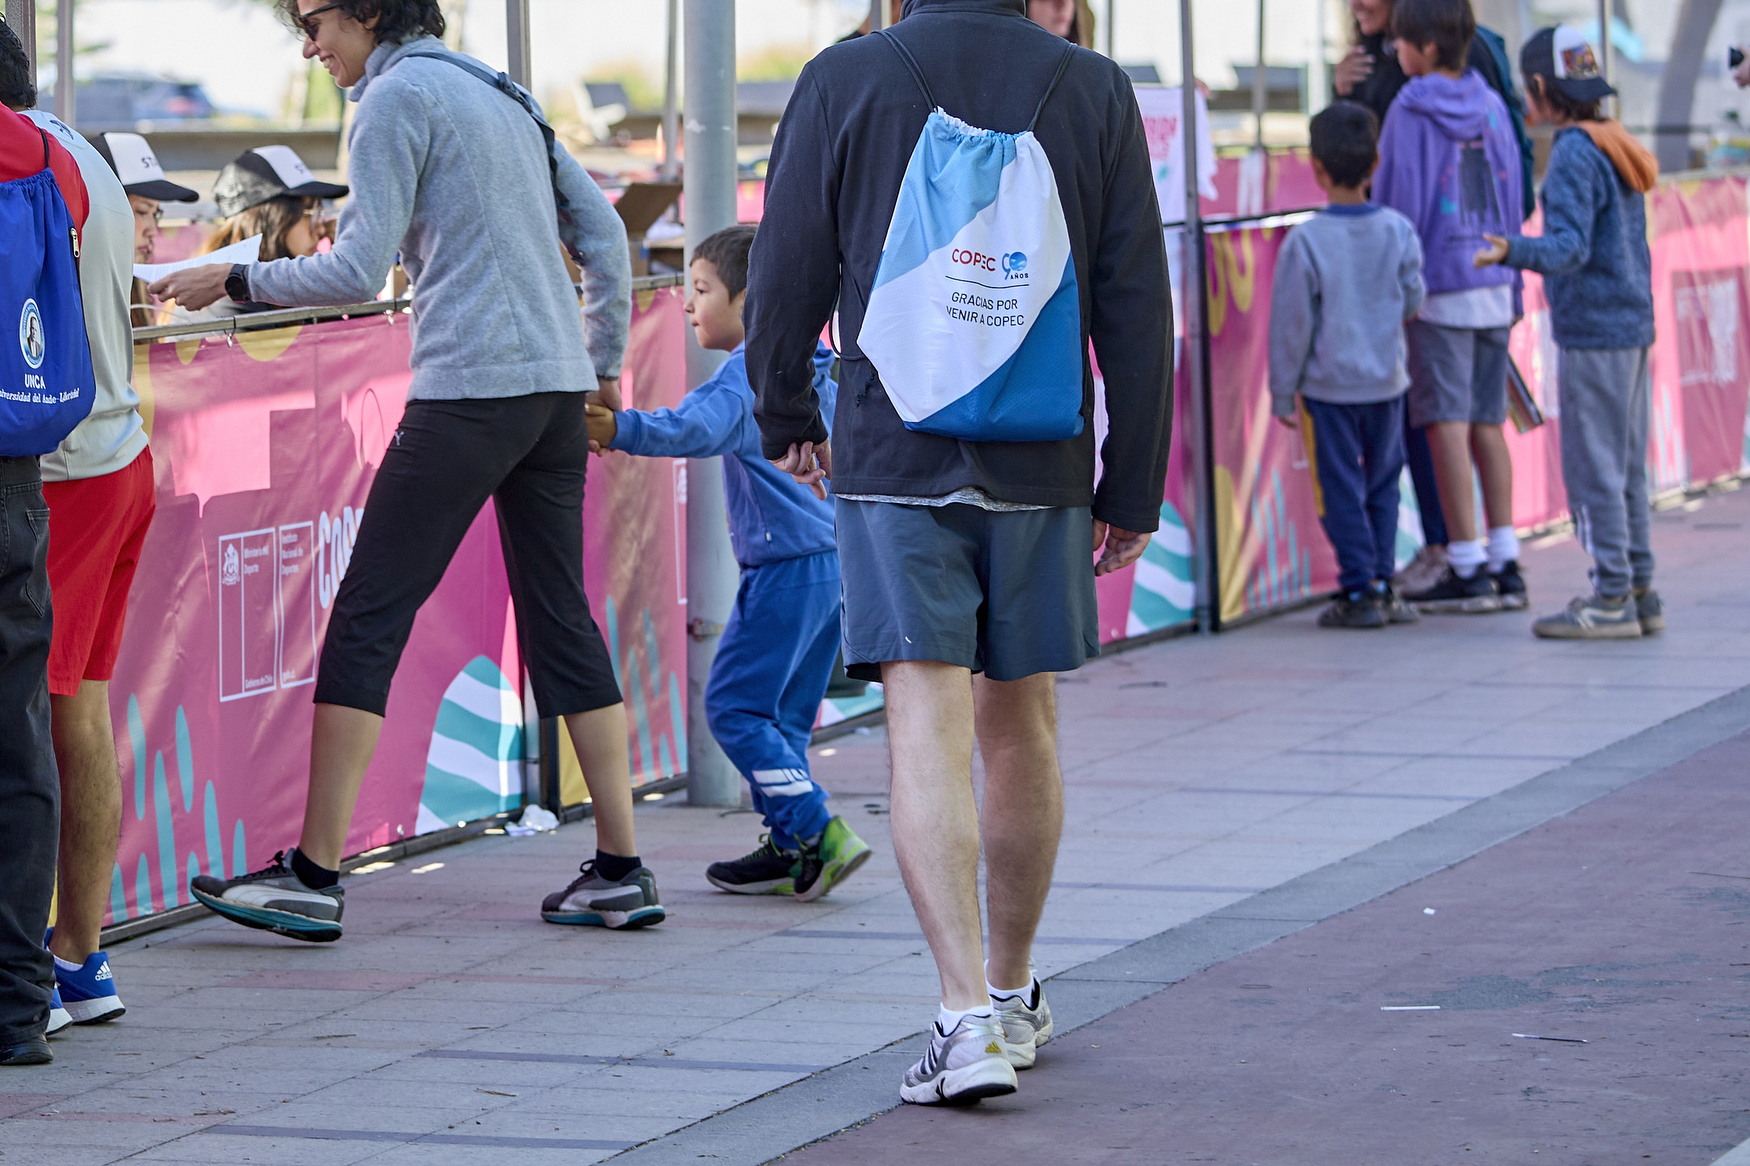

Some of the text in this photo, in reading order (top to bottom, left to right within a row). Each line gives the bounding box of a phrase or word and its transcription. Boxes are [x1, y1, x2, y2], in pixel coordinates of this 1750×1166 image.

[952, 248, 996, 271] COPEC
[1010, 272, 1029, 280] AÑOS
[951, 291, 1018, 311] GRACIAS POR
[946, 305, 1025, 327] VENIR A COPEC
[24, 373, 46, 390] UNCA
[32, 393, 41, 403] del
